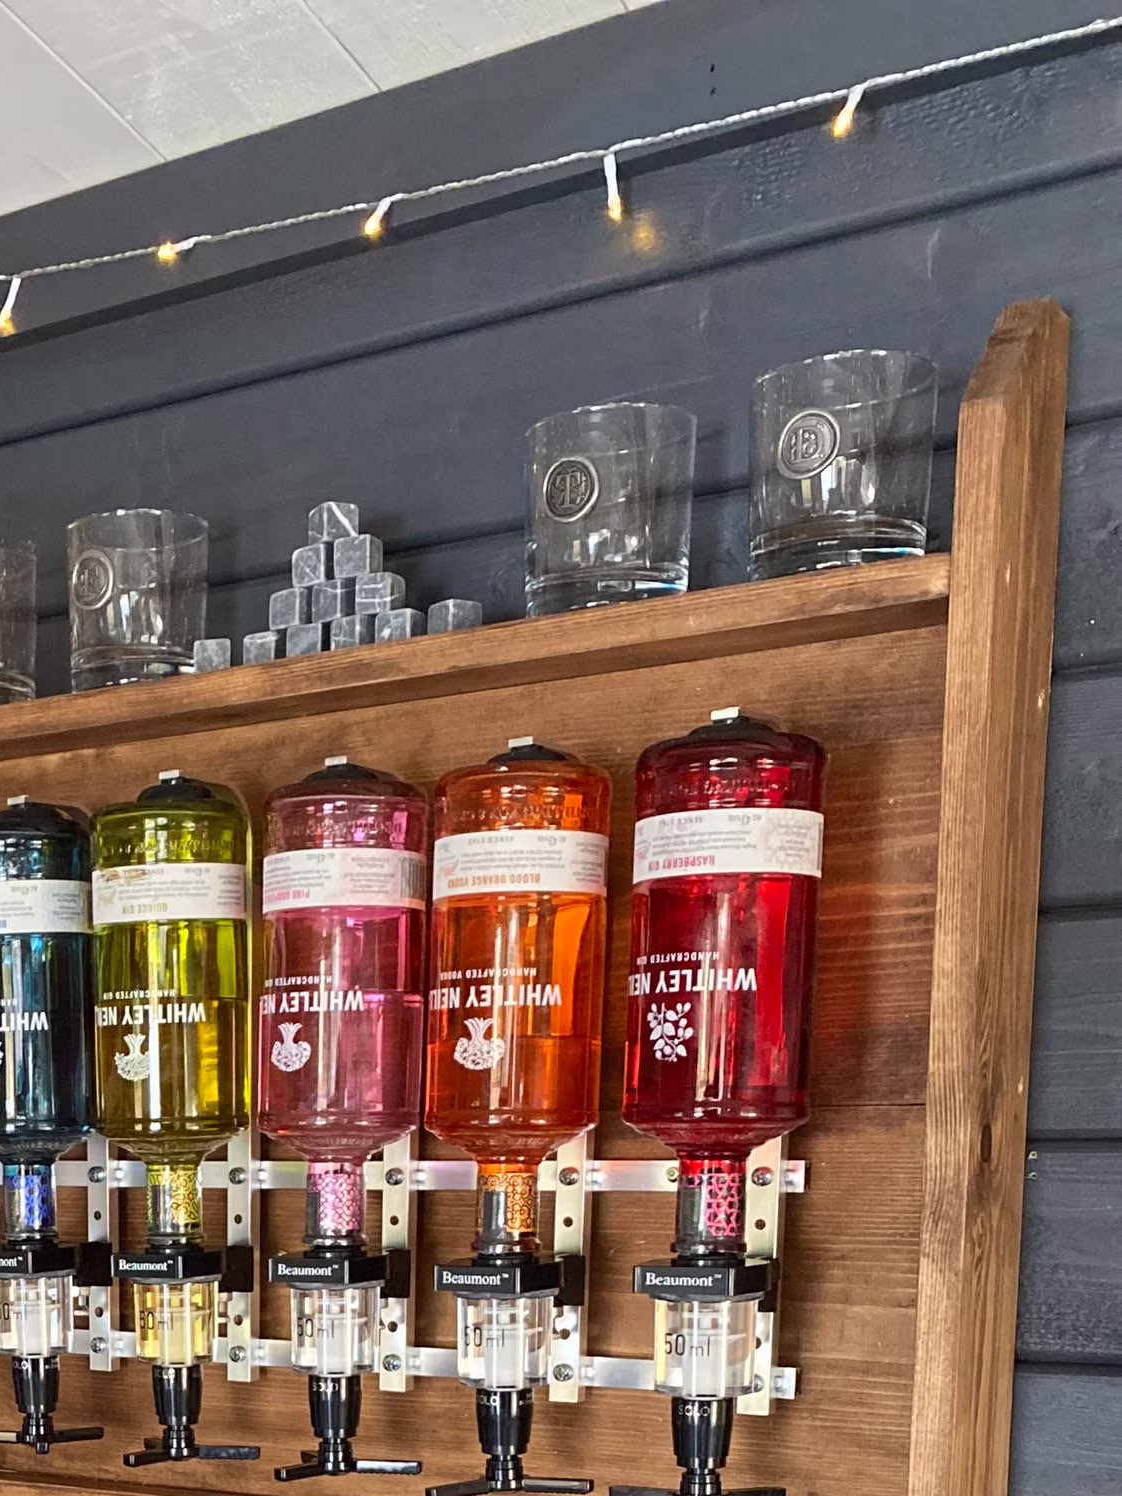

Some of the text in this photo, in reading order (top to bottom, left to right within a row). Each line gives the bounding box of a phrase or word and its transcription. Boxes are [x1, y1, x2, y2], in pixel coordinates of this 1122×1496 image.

[648, 855, 715, 872] RASPBERRY GIN
[472, 874, 506, 886] ORANGE
[510, 873, 541, 884] BLOOD
[137, 903, 168, 914] QUINCE
[651, 951, 719, 964] HANDCRAFTED
[275, 974, 333, 987] HANDCRAFTED
[466, 967, 536, 979] HANDCRAFTED
[656, 967, 757, 993] WHITLEY
[115, 988, 175, 1000] HANDCRAFTED
[279, 989, 365, 1013] WHITLEY
[466, 984, 562, 1008] WHITLEY
[122, 1002, 207, 1026] WHITLEY
[140, 1311, 154, 1330] 50
[297, 1317, 314, 1338] 50
[464, 1325, 482, 1347] 50
[665, 1332, 711, 1357] 50 ml
[678, 1404, 711, 1418] SOLO
